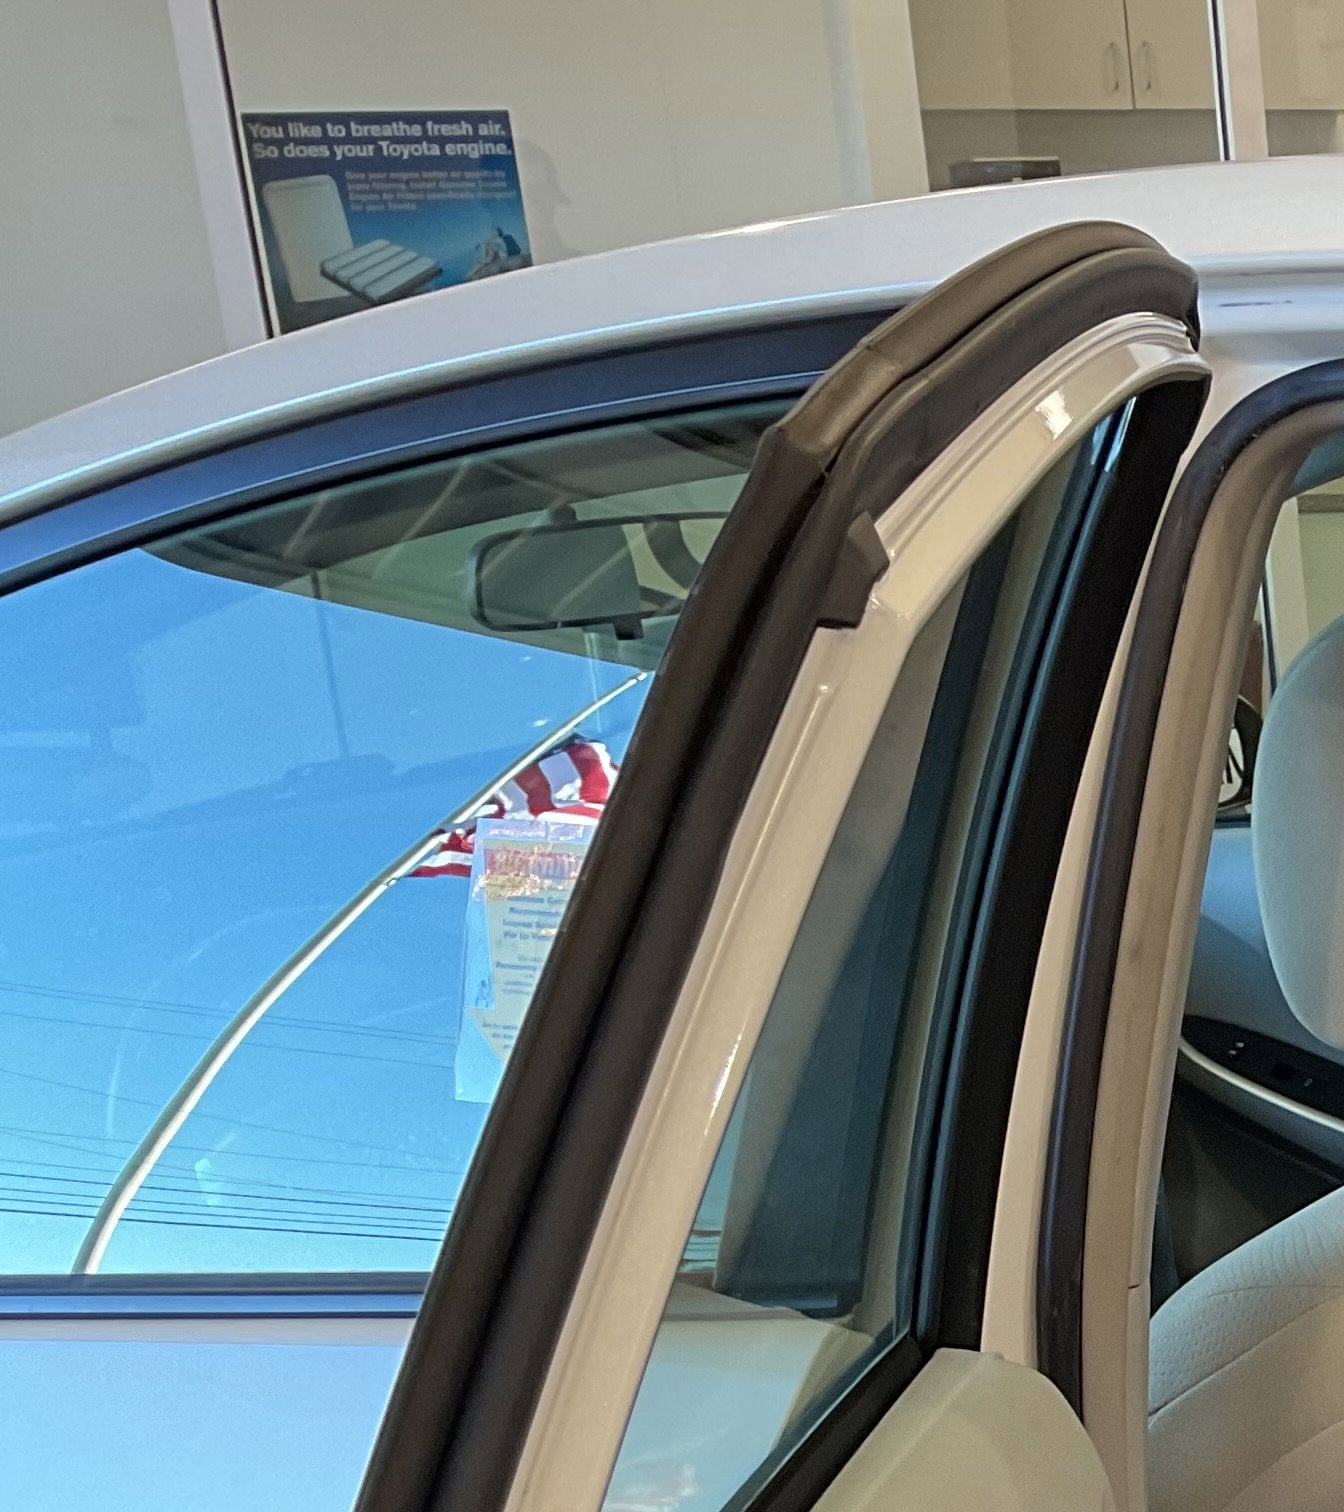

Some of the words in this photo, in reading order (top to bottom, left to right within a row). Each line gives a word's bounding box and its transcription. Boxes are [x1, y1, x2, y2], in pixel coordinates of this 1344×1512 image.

[247, 122, 284, 138] You
[288, 121, 322, 138] like
[326, 122, 346, 137] to
[350, 121, 422, 138] breathe
[426, 120, 473, 136] fresh
[478, 120, 506, 136] air.
[252, 142, 279, 158] So
[283, 142, 330, 158] does
[333, 143, 375, 161] your
[380, 140, 441, 160] Toyota
[445, 140, 512, 159] engine.
